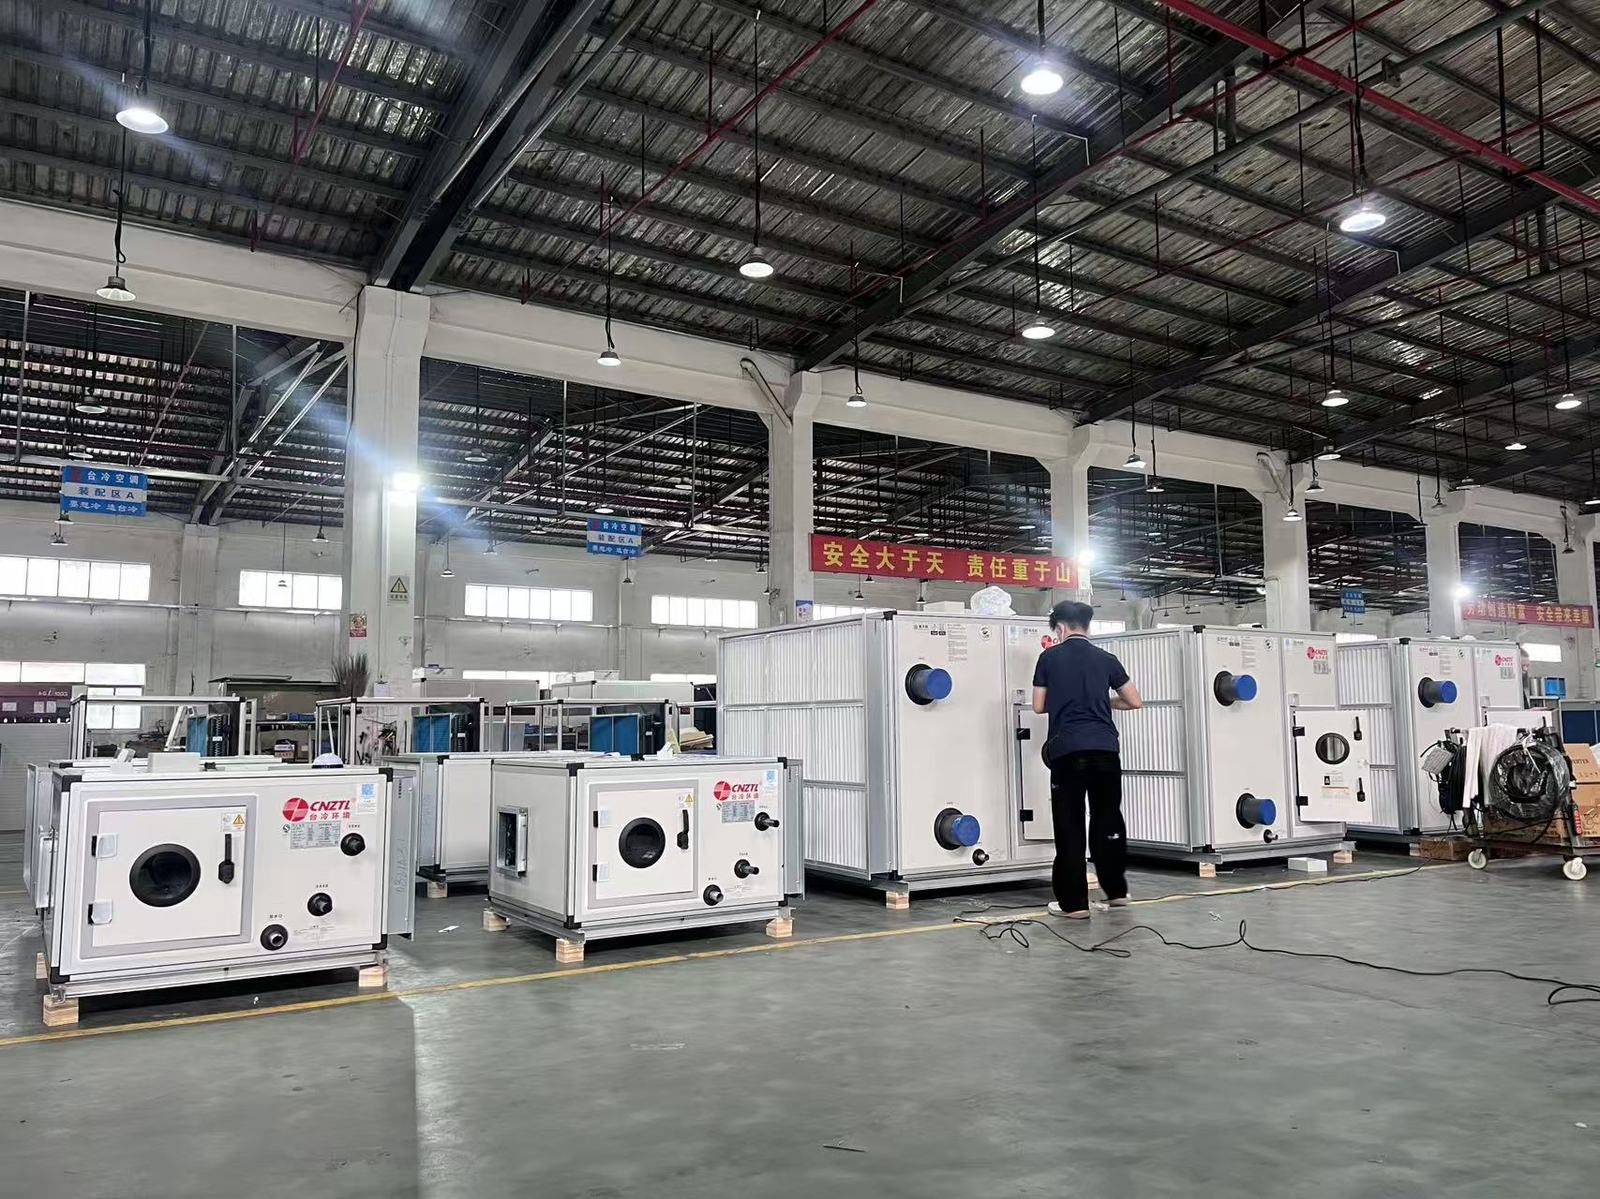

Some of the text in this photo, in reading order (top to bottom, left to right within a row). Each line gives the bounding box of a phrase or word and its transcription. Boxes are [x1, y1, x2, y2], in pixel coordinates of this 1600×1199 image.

[87, 470, 139, 485] 台冷空调
[823, 541, 1071, 584] 安全大于天 责任重于山
[731, 783, 759, 793] CNZTL
[310, 800, 351, 811] CNZTL
[309, 811, 351, 821] 台冷环境
